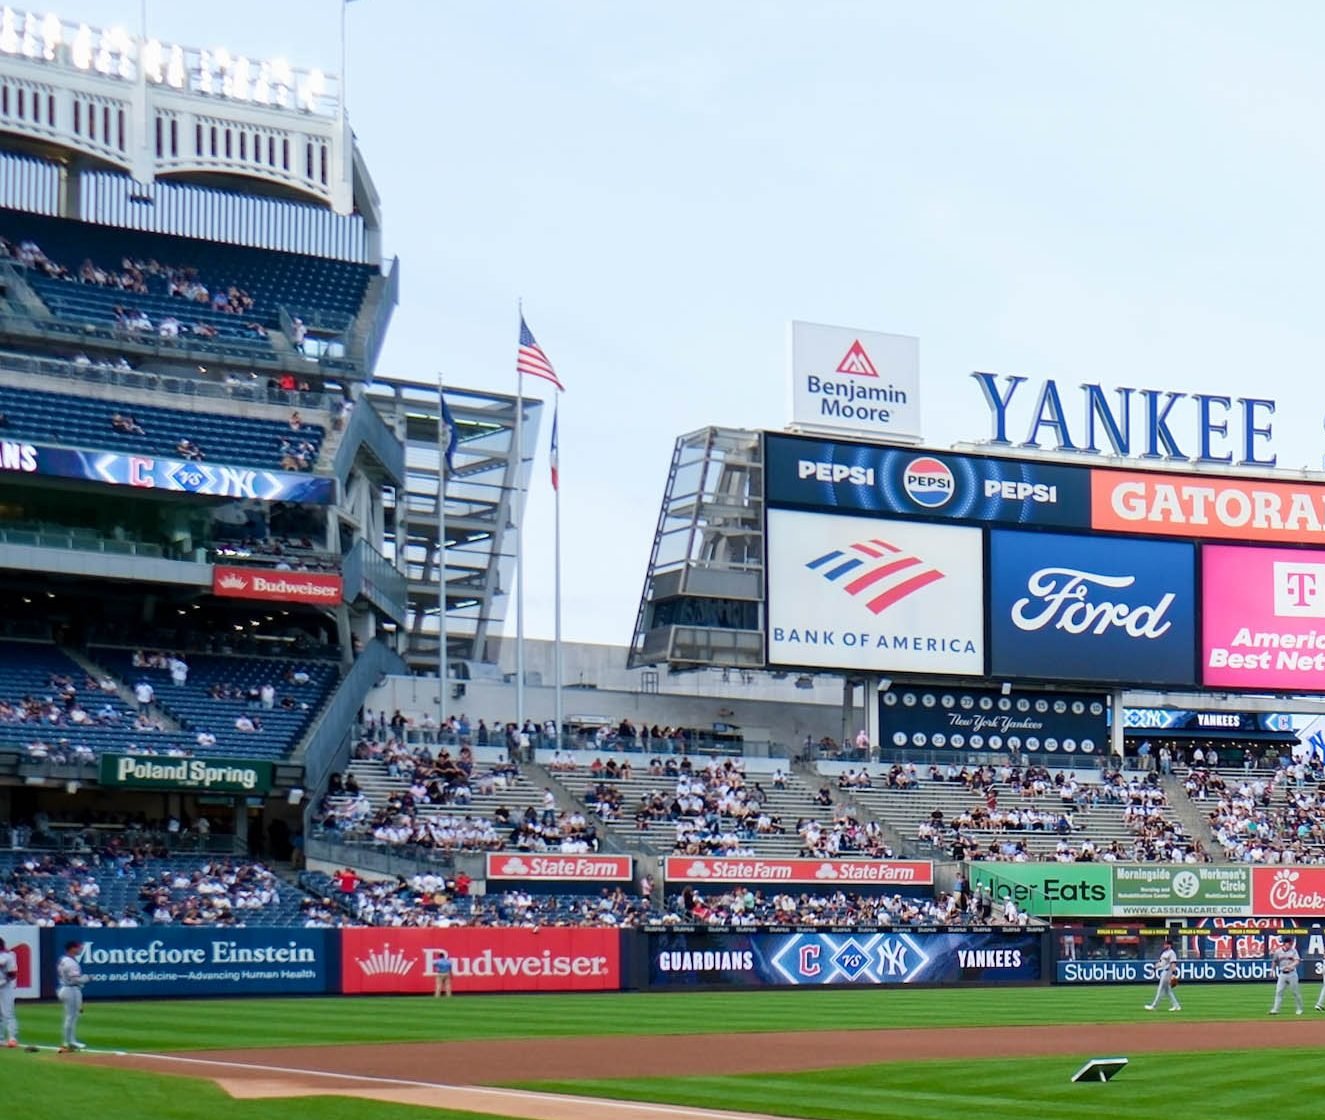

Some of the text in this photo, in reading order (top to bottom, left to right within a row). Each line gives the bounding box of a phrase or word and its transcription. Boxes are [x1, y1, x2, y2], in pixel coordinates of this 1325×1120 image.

[807, 375, 907, 404] Benjamin
[820, 398, 891, 422] Moore
[972, 371, 1278, 468] YANKEE
[0, 441, 37, 473] NS
[798, 460, 1057, 503] PEPSI PEPSI PEPSI
[253, 575, 339, 598] Budweiser
[1010, 567, 1176, 639] Ford
[773, 627, 977, 654] BANK OF AMERICA
[1209, 648, 1272, 670] Best
[948, 712, 1043, 733] New York Yankees
[1197, 713, 1241, 727] YANKEES
[118, 757, 258, 789] Poland Spring
[1117, 867, 1170, 882] Morningside
[1200, 868, 1246, 880] Workmen's
[1044, 879, 1106, 902] Eats
[1220, 880, 1246, 892] Circle
[1123, 906, 1242, 914] WWW.CASSENACARE.COM
[212, 940, 316, 964] Einstein
[421, 947, 609, 977] Budweiser
[659, 950, 754, 971] GUARDIANS
[957, 949, 1022, 969] YANKEES
[109, 971, 128, 981] and
[242, 970, 279, 980] Human
[281, 969, 316, 979] Health
[1064, 963, 1137, 982] StubHub
